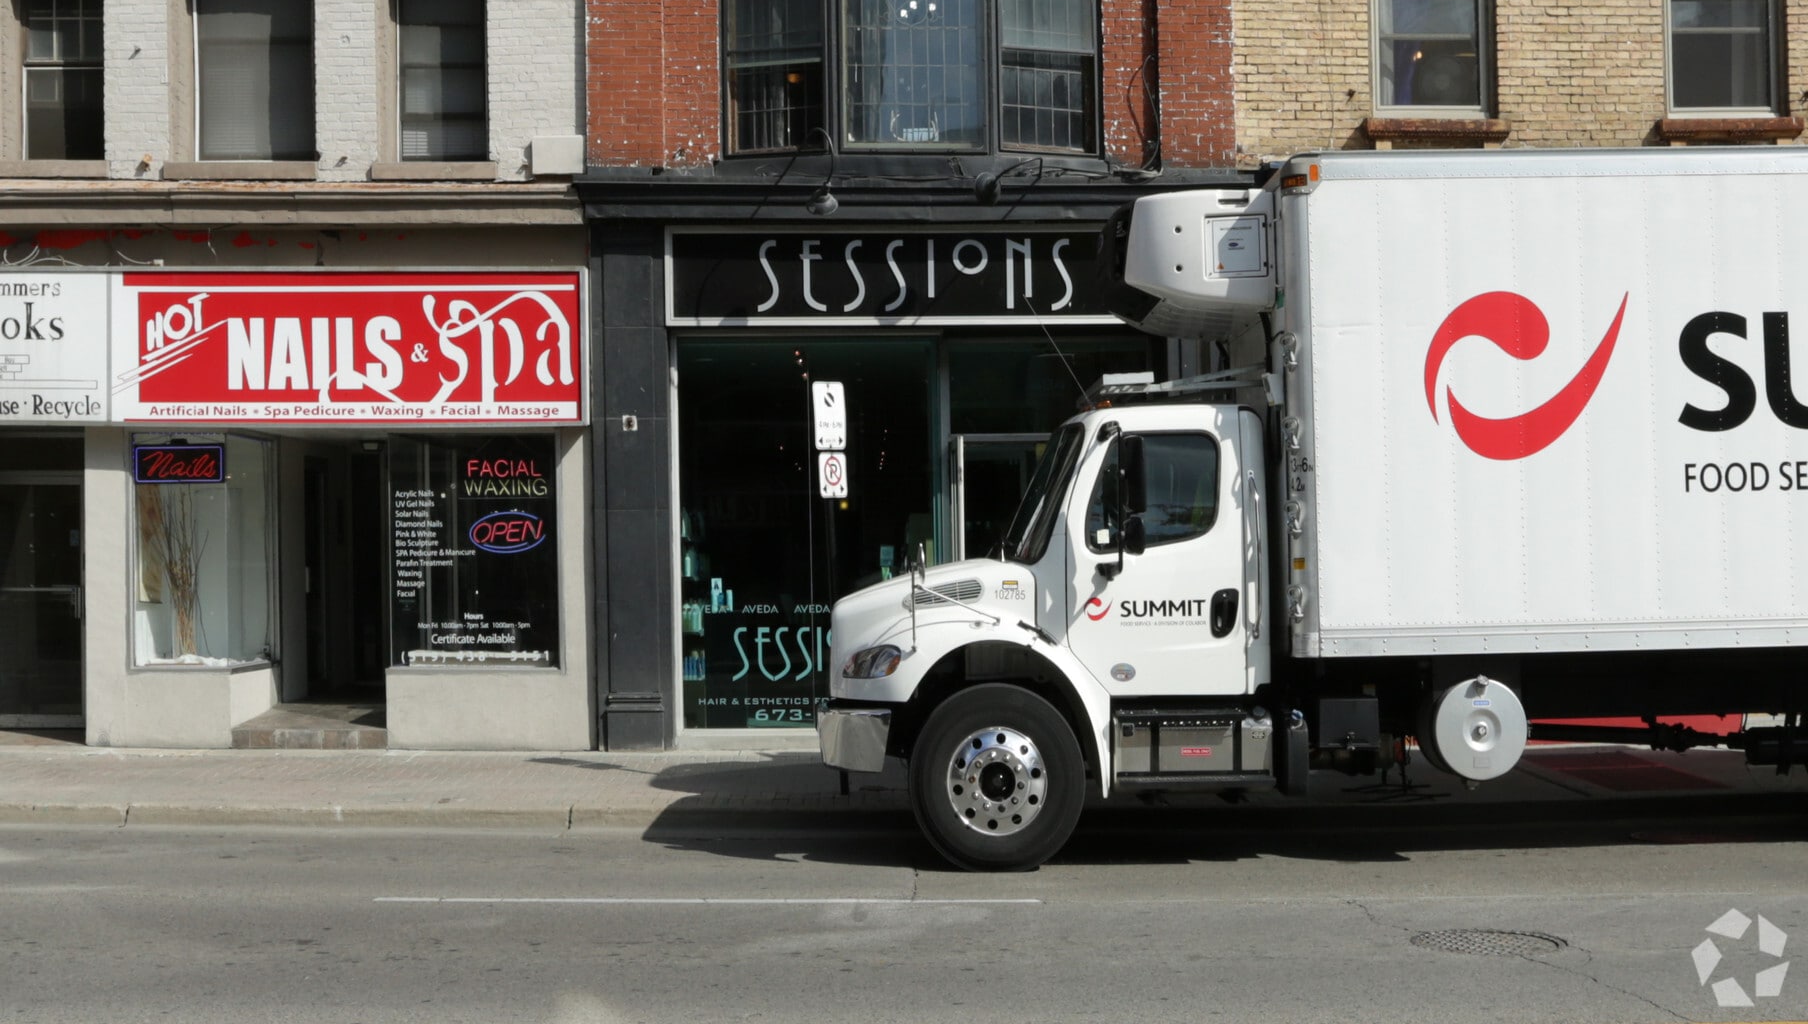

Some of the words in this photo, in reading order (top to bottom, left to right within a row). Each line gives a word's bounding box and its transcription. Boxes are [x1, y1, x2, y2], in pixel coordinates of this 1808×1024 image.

[757, 238, 1073, 312] SESSIONS
[1, 302, 64, 341] oks
[146, 293, 210, 351] HOT
[228, 315, 403, 392] NAILS
[411, 343, 429, 363] &
[32, 394, 102, 419] Recycle
[149, 405, 209, 416] Artificial
[213, 405, 248, 416] Nails
[264, 405, 290, 418] Spa
[294, 405, 355, 416] Pedicure
[371, 405, 424, 418] Waxing
[441, 405, 481, 416] Facial
[497, 405, 559, 418] Massage
[143, 451, 217, 478] Nails
[467, 460, 542, 477] FACIAL
[1685, 462, 1769, 492] FOOD
[464, 478, 548, 496] WAXING
[395, 490, 417, 498] Acrylic
[418, 490, 434, 498] Nails
[395, 500, 405, 508] UV
[406, 500, 418, 508] Gel
[418, 500, 435, 508] Nails
[395, 510, 412, 518] Solar
[413, 510, 429, 518] Nails
[395, 520, 426, 528] Diamond
[427, 520, 443, 528] Nails
[395, 530, 410, 538] Pink
[417, 530, 437, 538] White
[473, 520, 543, 544] OPEN
[395, 539, 407, 547] Bio
[407, 539, 439, 547] Sculpture
[396, 549, 408, 557] SPA
[409, 549, 438, 557] Pedicure
[445, 549, 476, 557] Manicure
[419, 559, 453, 567] Treatment
[397, 570, 422, 579] Waxing
[397, 580, 425, 588] Massage
[994, 589, 1026, 600] 102785
[742, 604, 779, 614] AVEDA
[793, 604, 831, 614] AVEDA
[1120, 599, 1206, 618] SUMMIT
[464, 612, 484, 620] Hours
[431, 633, 475, 644] Certificate
[476, 633, 516, 644] Available
[698, 697, 727, 705] HAIR
[731, 697, 740, 705] &
[744, 697, 810, 705] ESTHETICS
